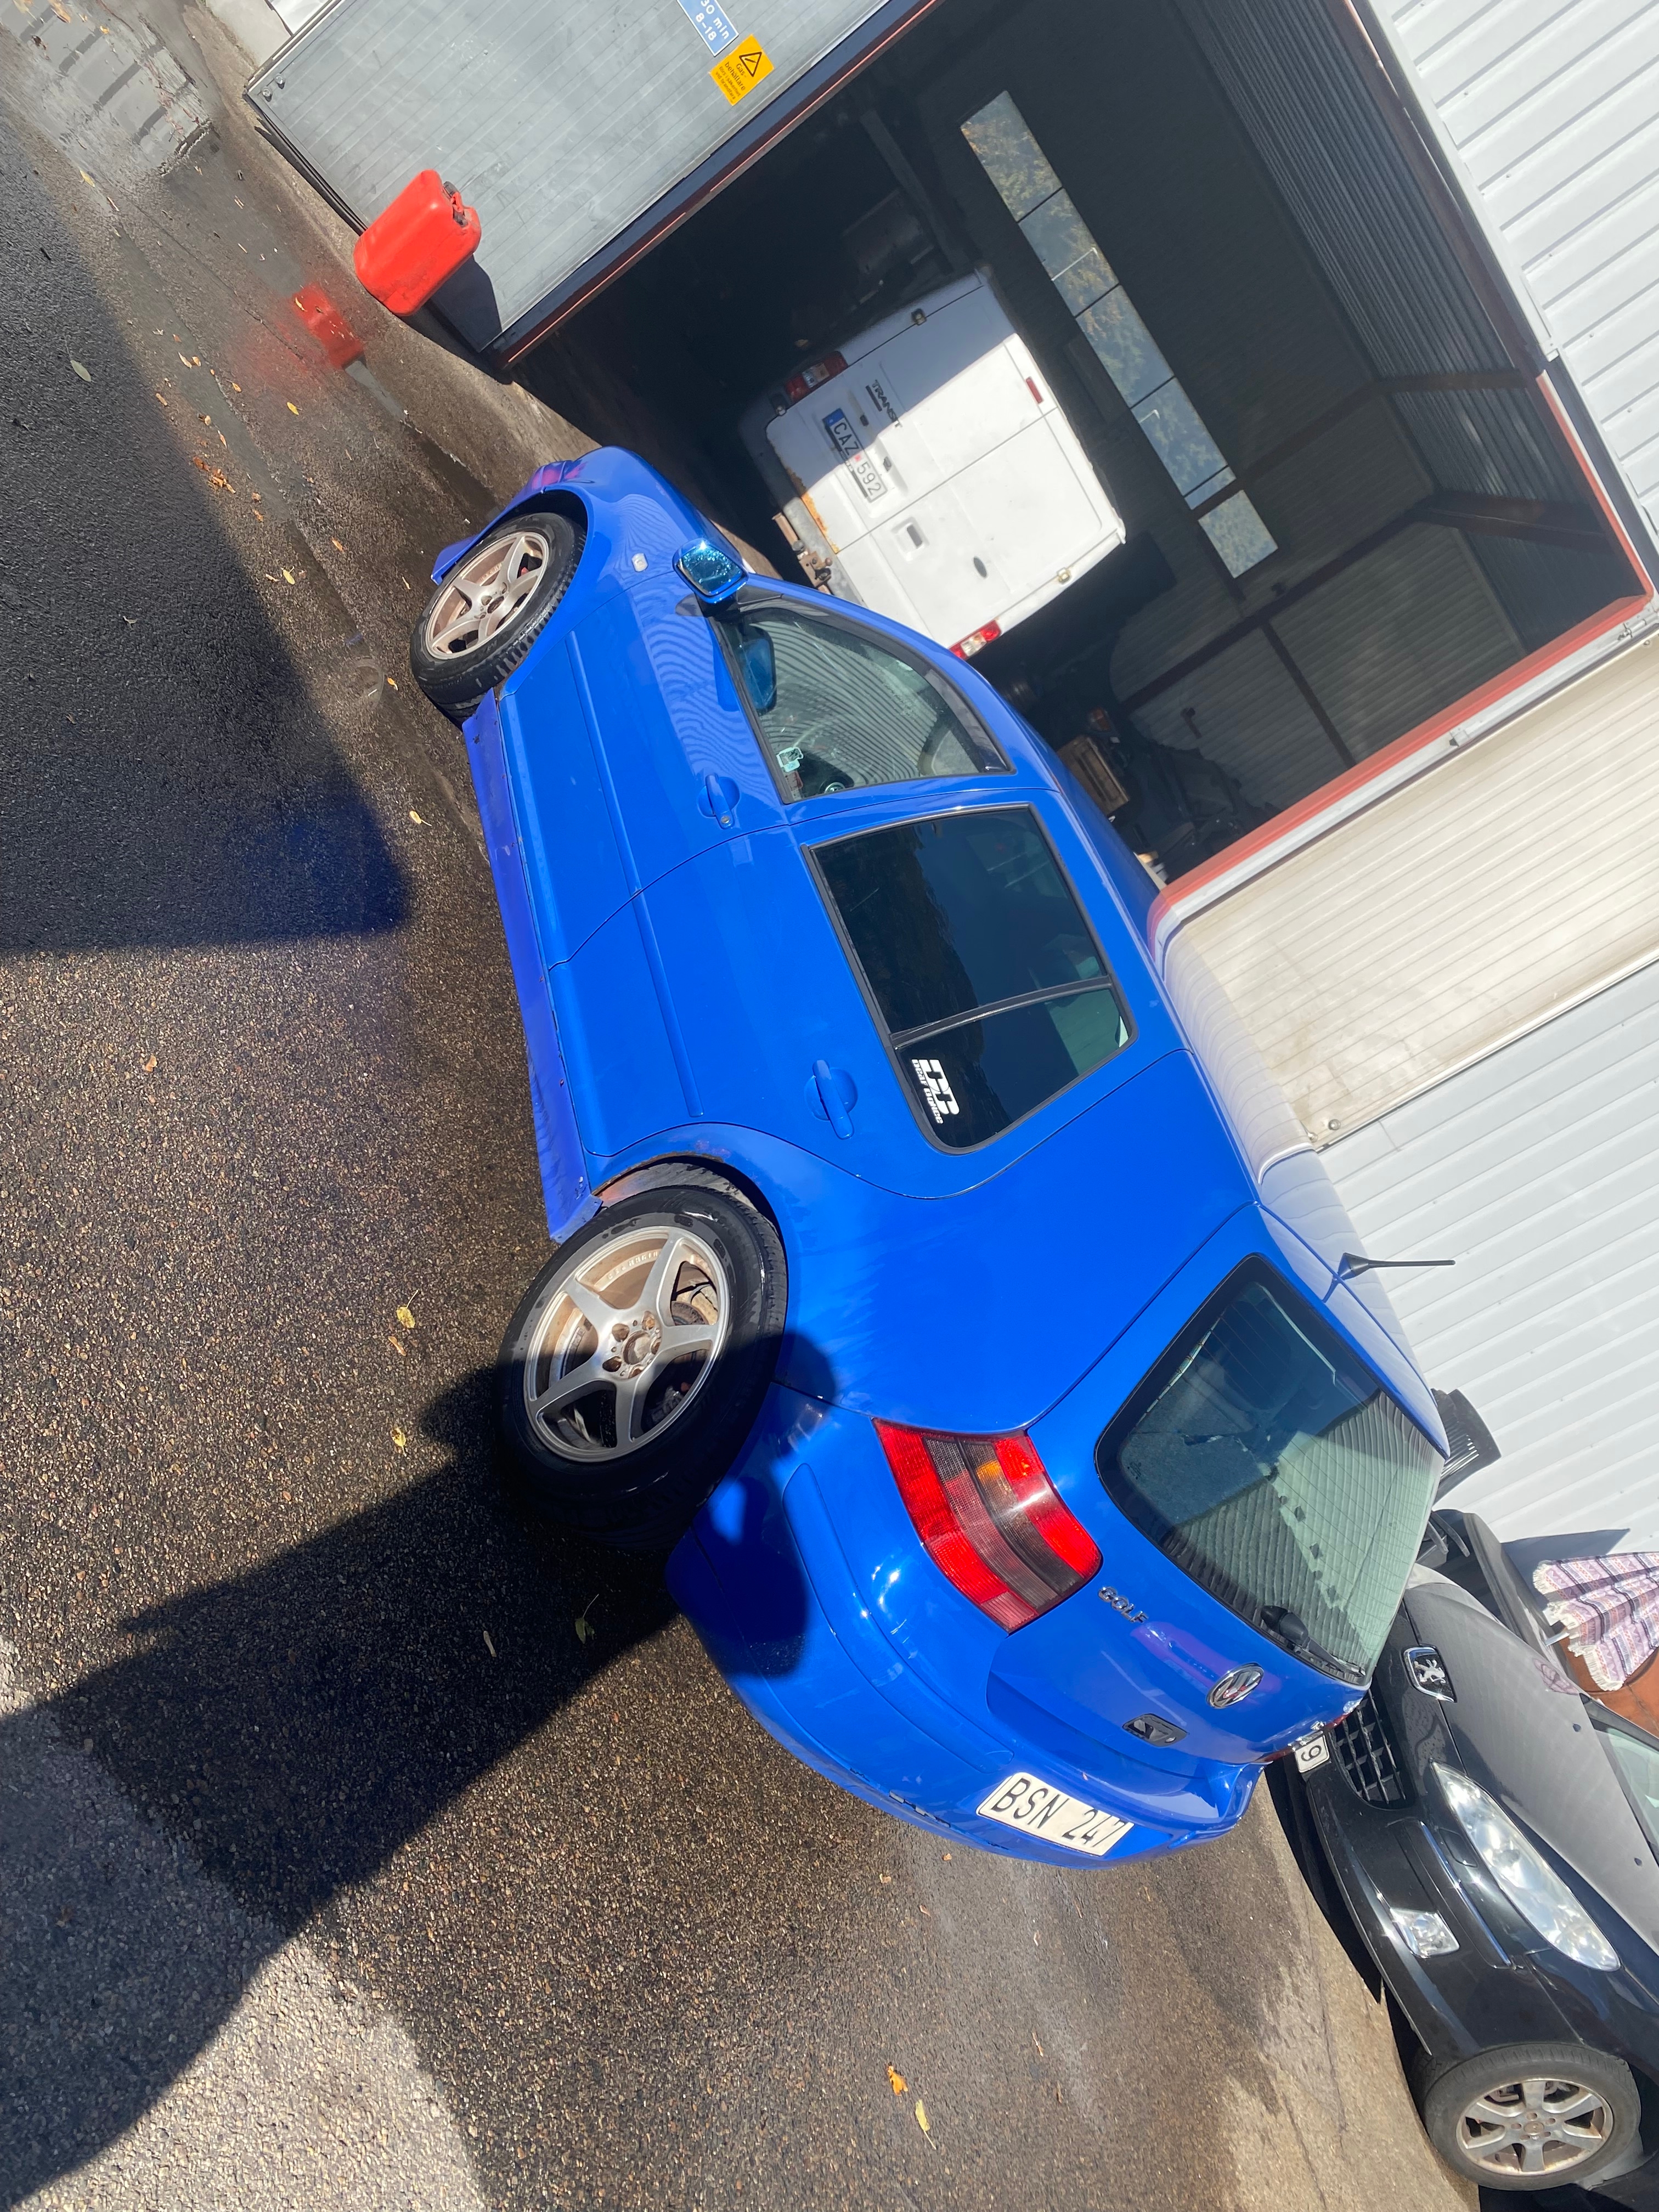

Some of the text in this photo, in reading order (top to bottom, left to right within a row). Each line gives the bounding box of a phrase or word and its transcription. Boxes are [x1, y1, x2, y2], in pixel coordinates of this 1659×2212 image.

[696, 13, 717, 41] 8-18
[713, 17, 729, 40] min
[833, 422, 859, 456] CAZ
[857, 461, 882, 495] 592
[1098, 1585, 1149, 1623] GOLF
[990, 1778, 1126, 1848] BSN 247
